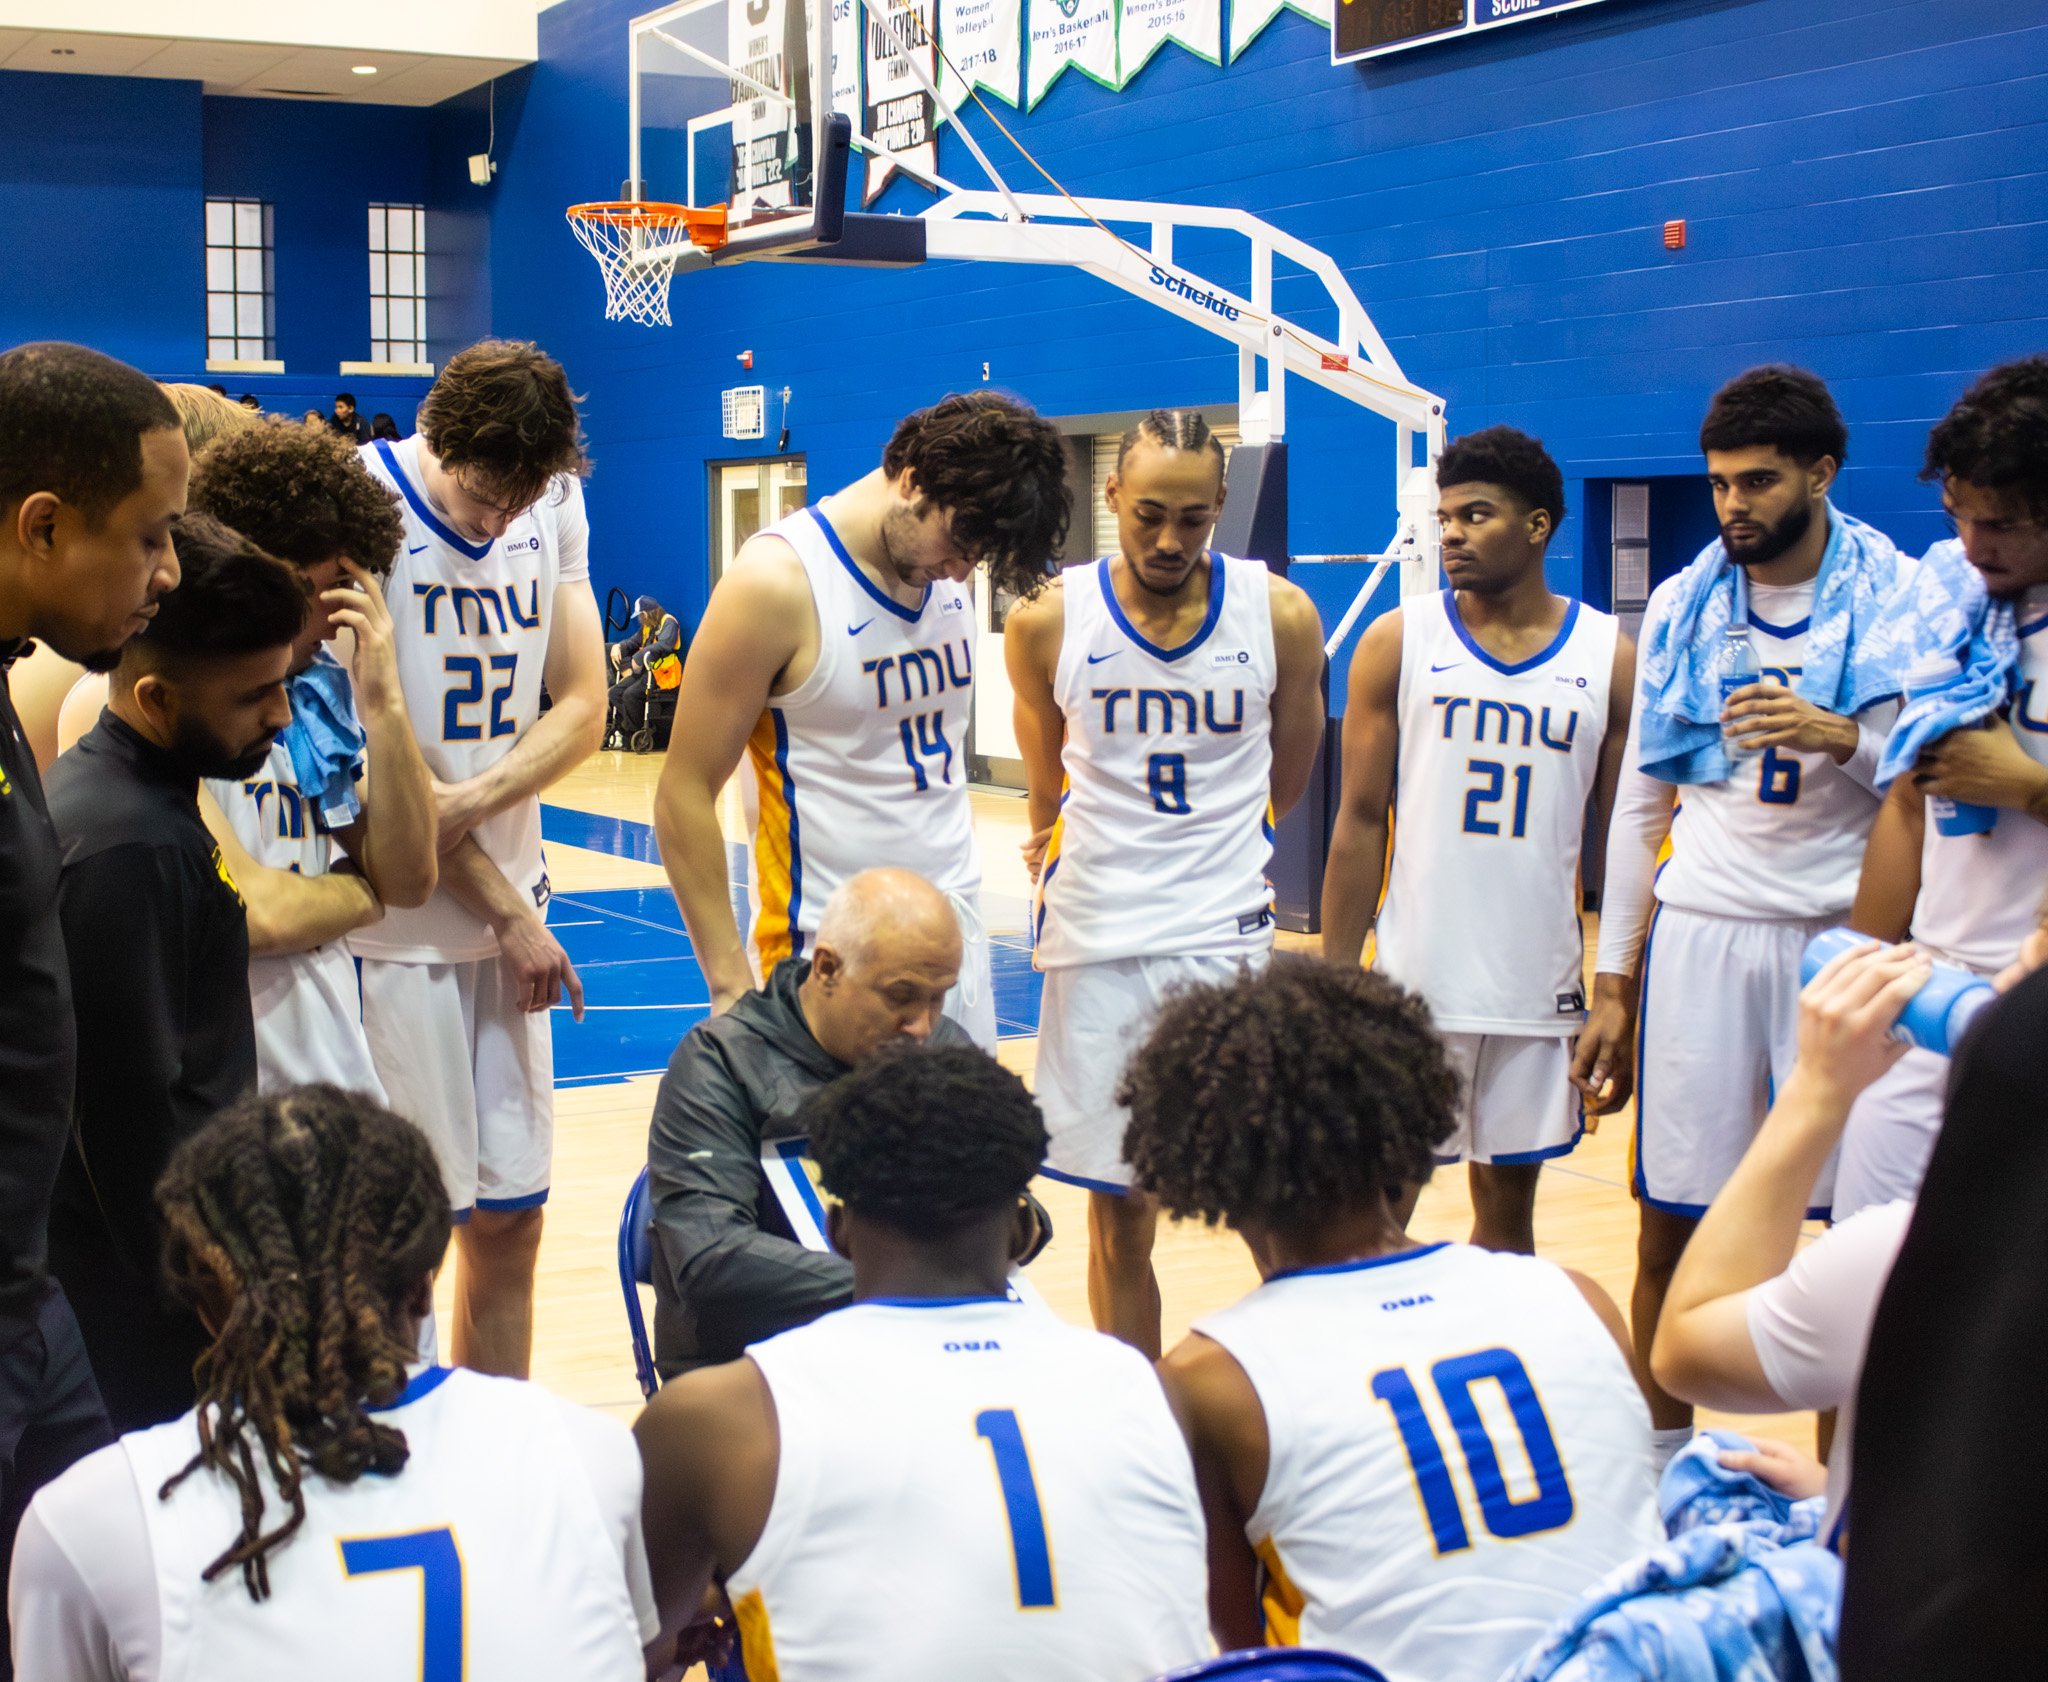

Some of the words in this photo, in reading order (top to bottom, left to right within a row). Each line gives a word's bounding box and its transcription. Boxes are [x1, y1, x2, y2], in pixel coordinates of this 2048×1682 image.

[1054, 35, 1087, 55] 2016-17
[1147, 9, 1186, 29] 2015-16
[1148, 265, 1240, 322] Scheide
[507, 541, 529, 552] BMO
[412, 576, 541, 637] TMU
[441, 651, 519, 744] 22
[862, 637, 972, 710] TMU
[1089, 686, 1245, 735] TMU
[1431, 694, 1579, 754] TMU
[898, 708, 953, 792] 14
[1755, 747, 1803, 807] 6
[1145, 750, 1193, 815] 8
[1460, 757, 1534, 841] 21
[1367, 1345, 1577, 1562] 10
[970, 1405, 1060, 1612] 1
[333, 1522, 469, 1682] 7
